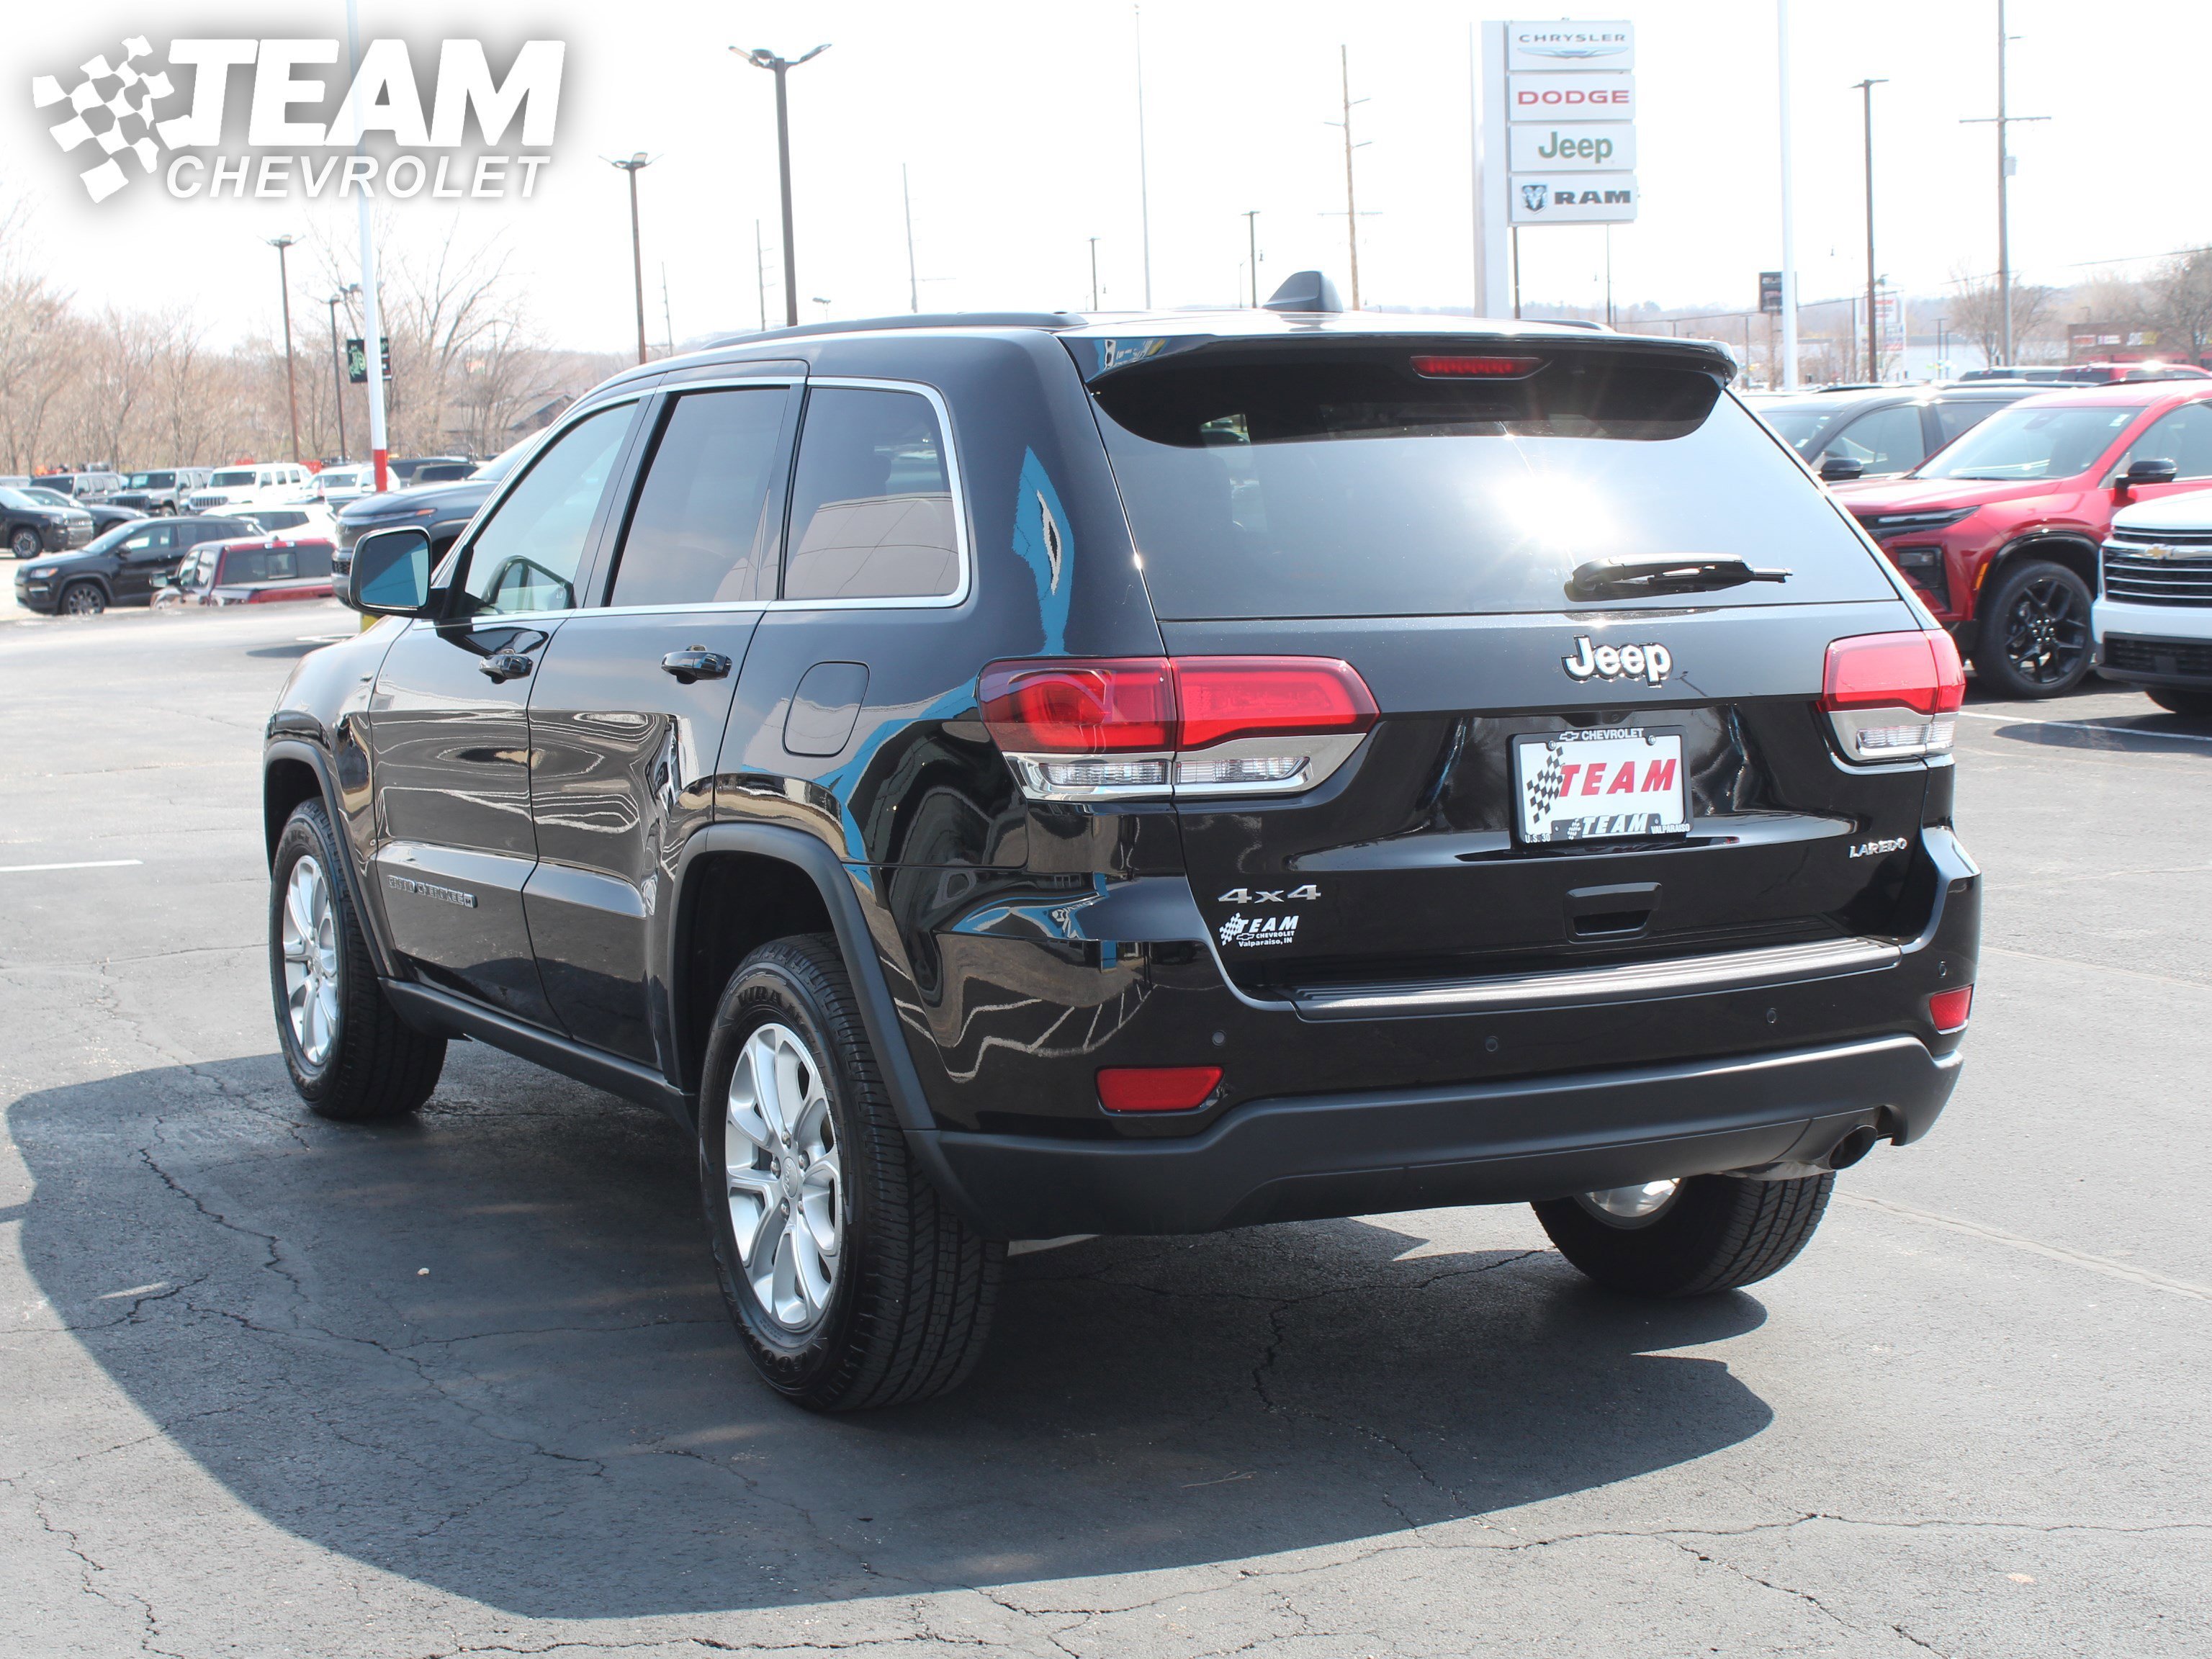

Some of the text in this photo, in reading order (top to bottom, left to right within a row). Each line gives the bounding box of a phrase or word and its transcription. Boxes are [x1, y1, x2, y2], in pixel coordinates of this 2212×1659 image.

[1519, 34, 1626, 42] CHRYSLER
[1518, 90, 1629, 104] DODGE
[1538, 131, 1613, 163] Jeep
[1554, 190, 1631, 204] RAM
[1561, 634, 1673, 688] Jeep
[1581, 728, 1644, 741] CHEVROLET
[1559, 758, 1677, 798] TEAM
[1582, 812, 1649, 835] TEAM
[1651, 823, 1691, 835] VALPARAISO
[1524, 833, 1551, 843] U.S. 30
[1849, 837, 1908, 858] LAREDO
[1218, 884, 1321, 904] 4x4
[1237, 915, 1299, 933] TEAM
[1238, 939, 1283, 948] Valparaiso,
